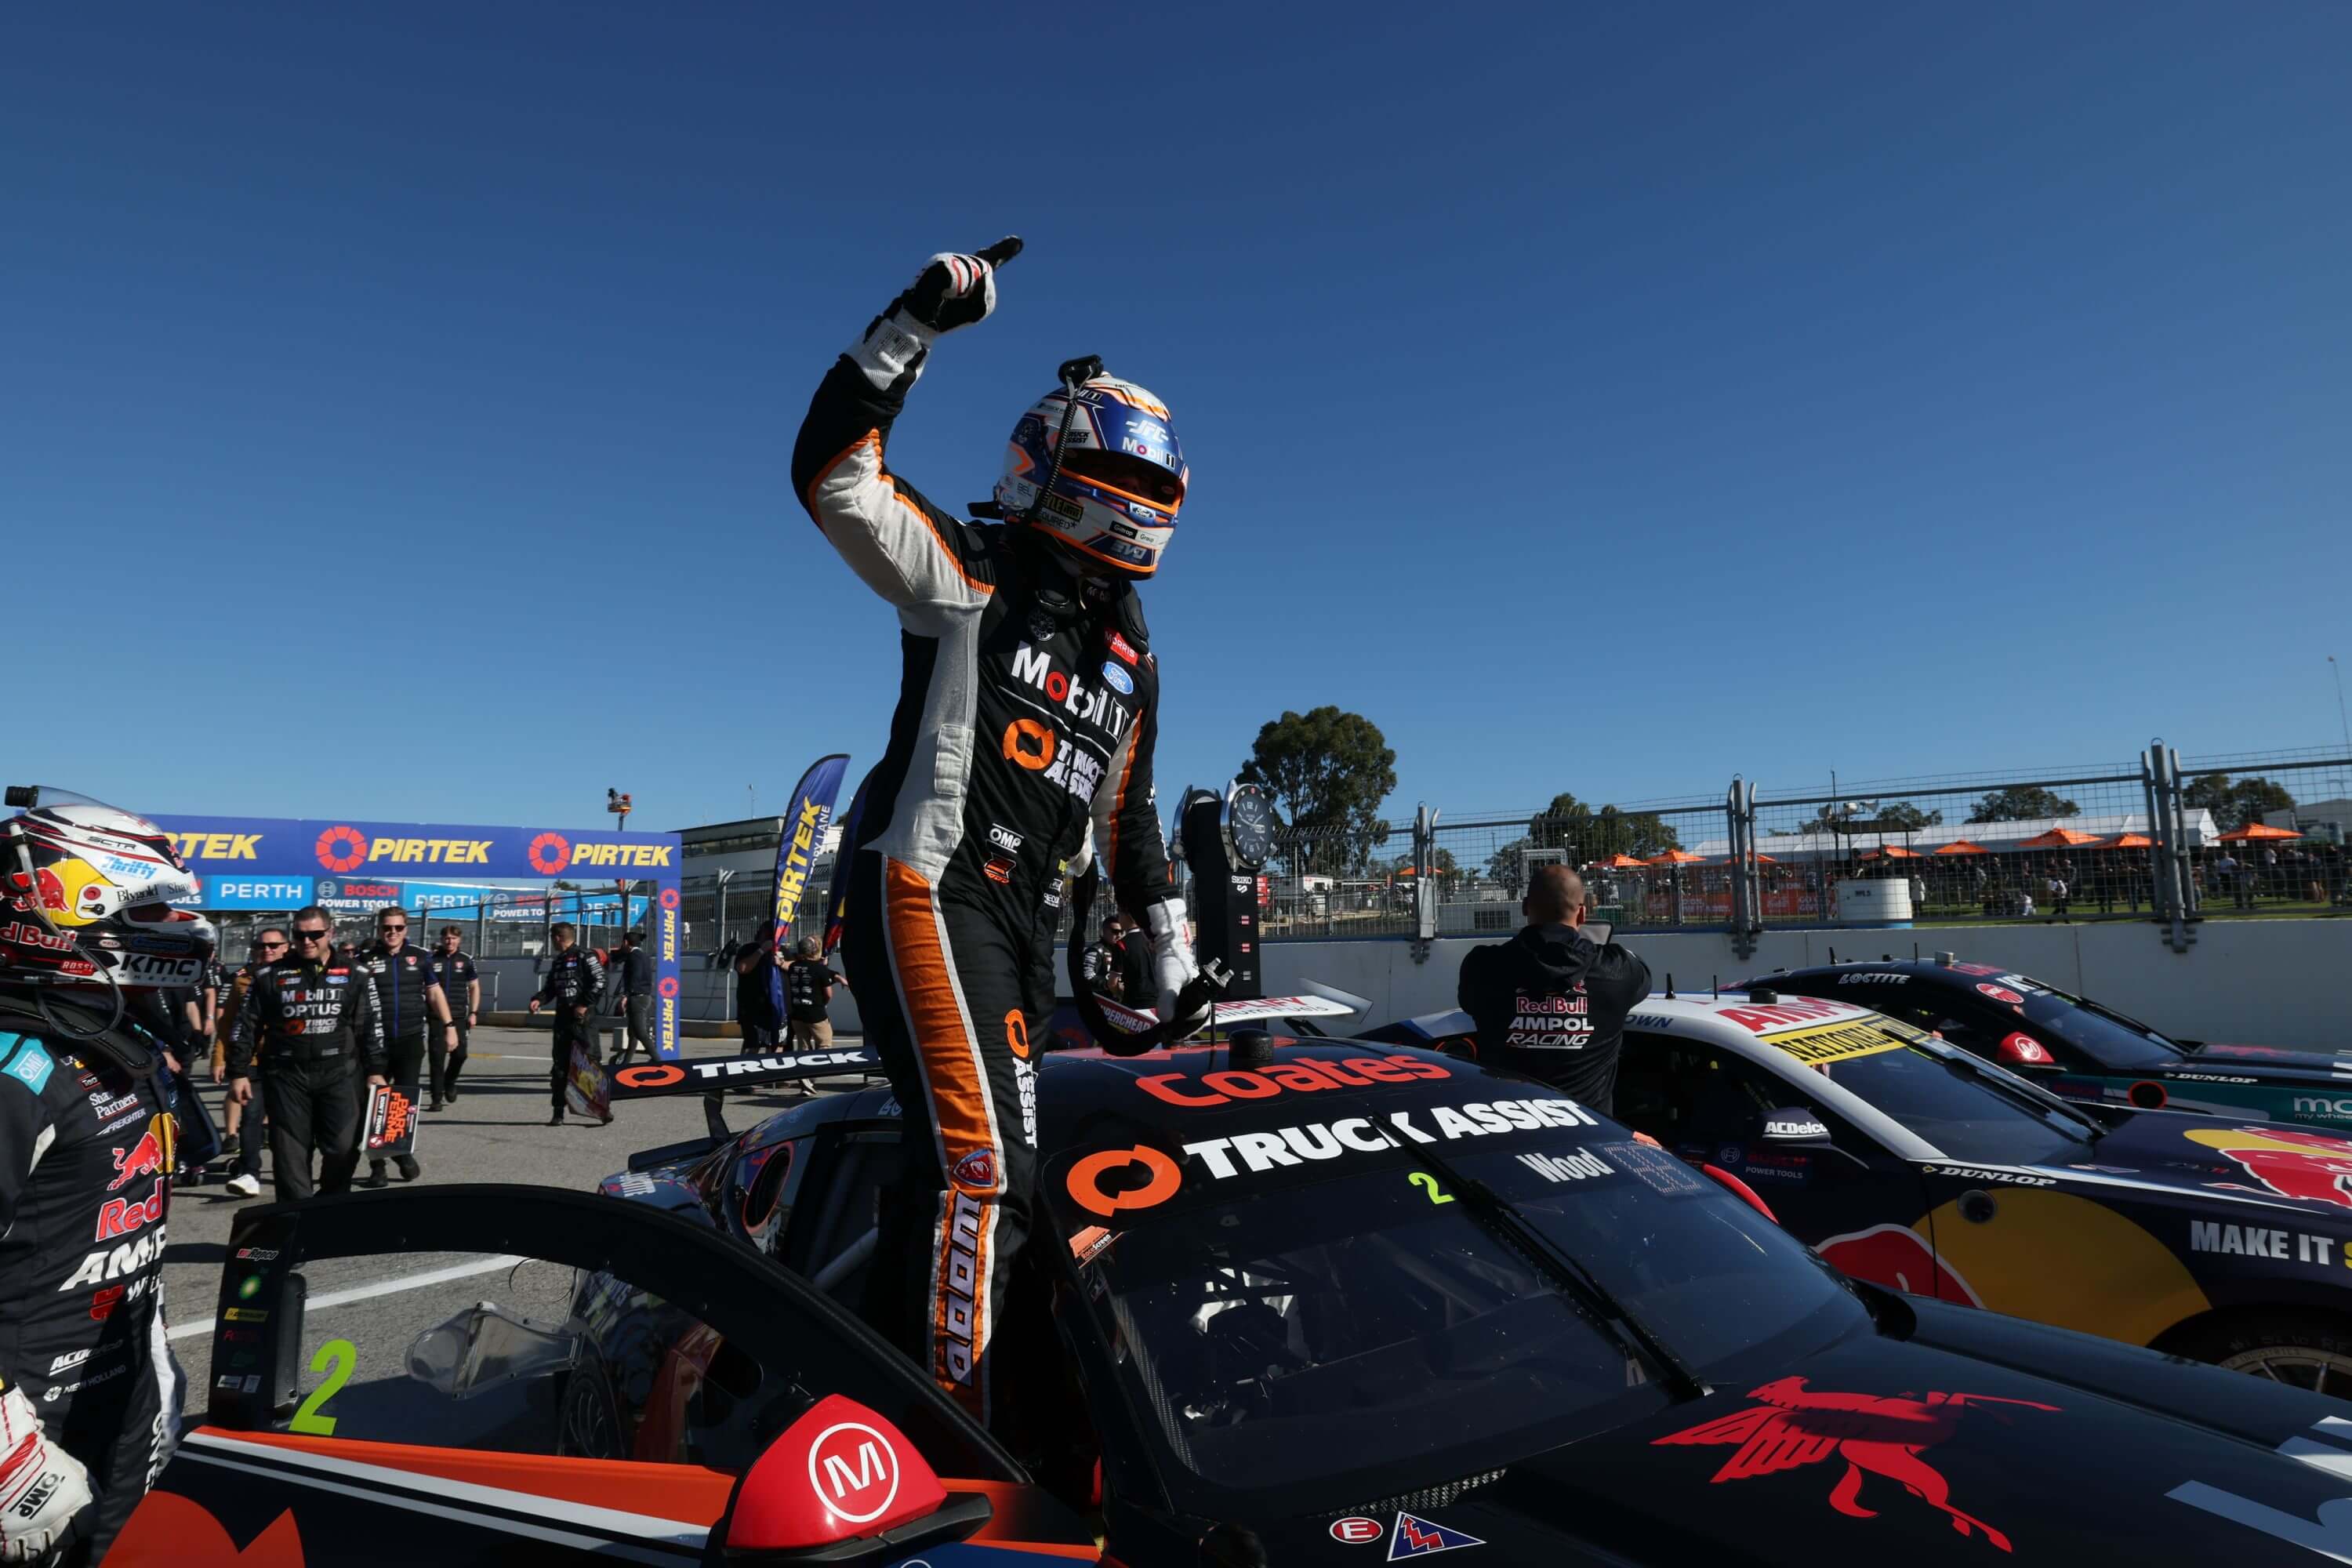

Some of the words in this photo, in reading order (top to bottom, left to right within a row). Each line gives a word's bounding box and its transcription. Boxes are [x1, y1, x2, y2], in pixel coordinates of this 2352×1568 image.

[1122, 436, 1163, 463] Mobil
[1011, 641, 1107, 728] Mobil
[816, 804, 831, 842] LANE
[87, 836, 137, 851] SCTR
[989, 827, 1022, 849] OMP
[368, 838, 493, 863] PIRTEK
[571, 844, 673, 866] PIRTEK
[220, 883, 303, 899] PERTH
[343, 884, 399, 897] BOSCH
[1231, 876, 1252, 884] SEIKO
[117, 886, 158, 902] Blygold
[317, 898, 358, 909] POWER
[361, 899, 397, 910] TOOLS
[663, 909, 675, 963] PIRTEK
[1838, 973, 1911, 985] LOCTITE
[281, 989, 324, 1003] Mobil
[1516, 996, 1552, 1014] Red
[1553, 996, 1588, 1014] Bull
[282, 1004, 342, 1018] OPTUS
[305, 1018, 338, 1026] TRUCK
[1623, 1014, 1674, 1029] OWN
[662, 999, 674, 1052] PIRTEK
[1508, 1017, 1595, 1031] AMPOL
[1506, 1033, 1590, 1046] RACING
[692, 1052, 869, 1079] TRUCK
[1134, 1054, 1452, 1107] Coates
[2176, 1073, 2258, 1084] DUNLOP
[94, 1093, 139, 1120] Partners
[1012, 1057, 1037, 1149] ASSIST
[384, 1092, 402, 1143] FERME
[395, 1098, 409, 1138] PARC
[1181, 1112, 1438, 1180] TRUCK
[1430, 1098, 1600, 1140] ASSIST
[1515, 1147, 1616, 1183] Wood
[1745, 1166, 1775, 1177] POWER
[1777, 1169, 1803, 1179] TOOLS
[1408, 1171, 1456, 1204] 2
[1940, 1166, 2056, 1187] DUNLOP
[96, 1176, 164, 1242] Red
[2191, 1220, 2290, 1260] MAKE
[2298, 1233, 2335, 1265] IT
[63, 1382, 87, 1395] NEW
[288, 1338, 358, 1436] 2
[823, 1440, 887, 1499] M
[18, 1473, 60, 1518] OMP
[1341, 1521, 1372, 1541] E
